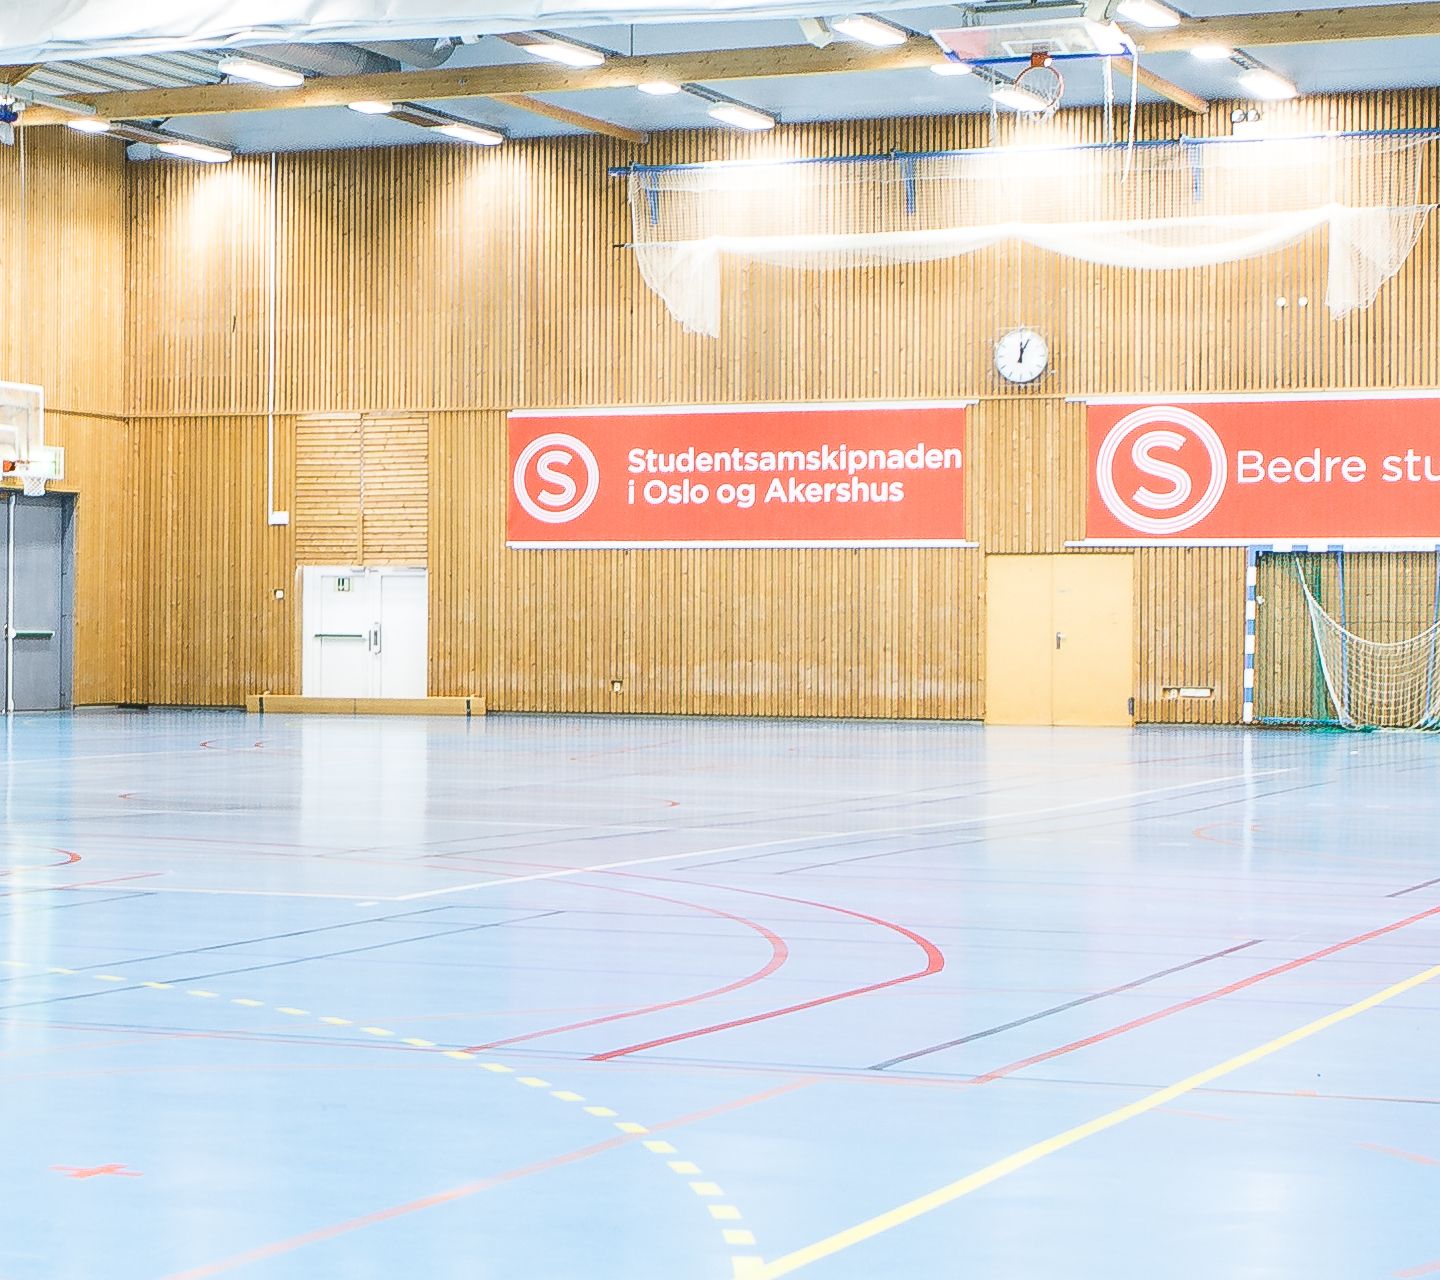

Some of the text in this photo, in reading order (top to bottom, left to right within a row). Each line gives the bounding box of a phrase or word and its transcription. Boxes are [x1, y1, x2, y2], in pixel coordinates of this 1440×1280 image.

[627, 442, 962, 476] Studentsamskipnaden
[1236, 447, 1367, 484] Bedre
[627, 476, 904, 508] i Oslo og Akershus
